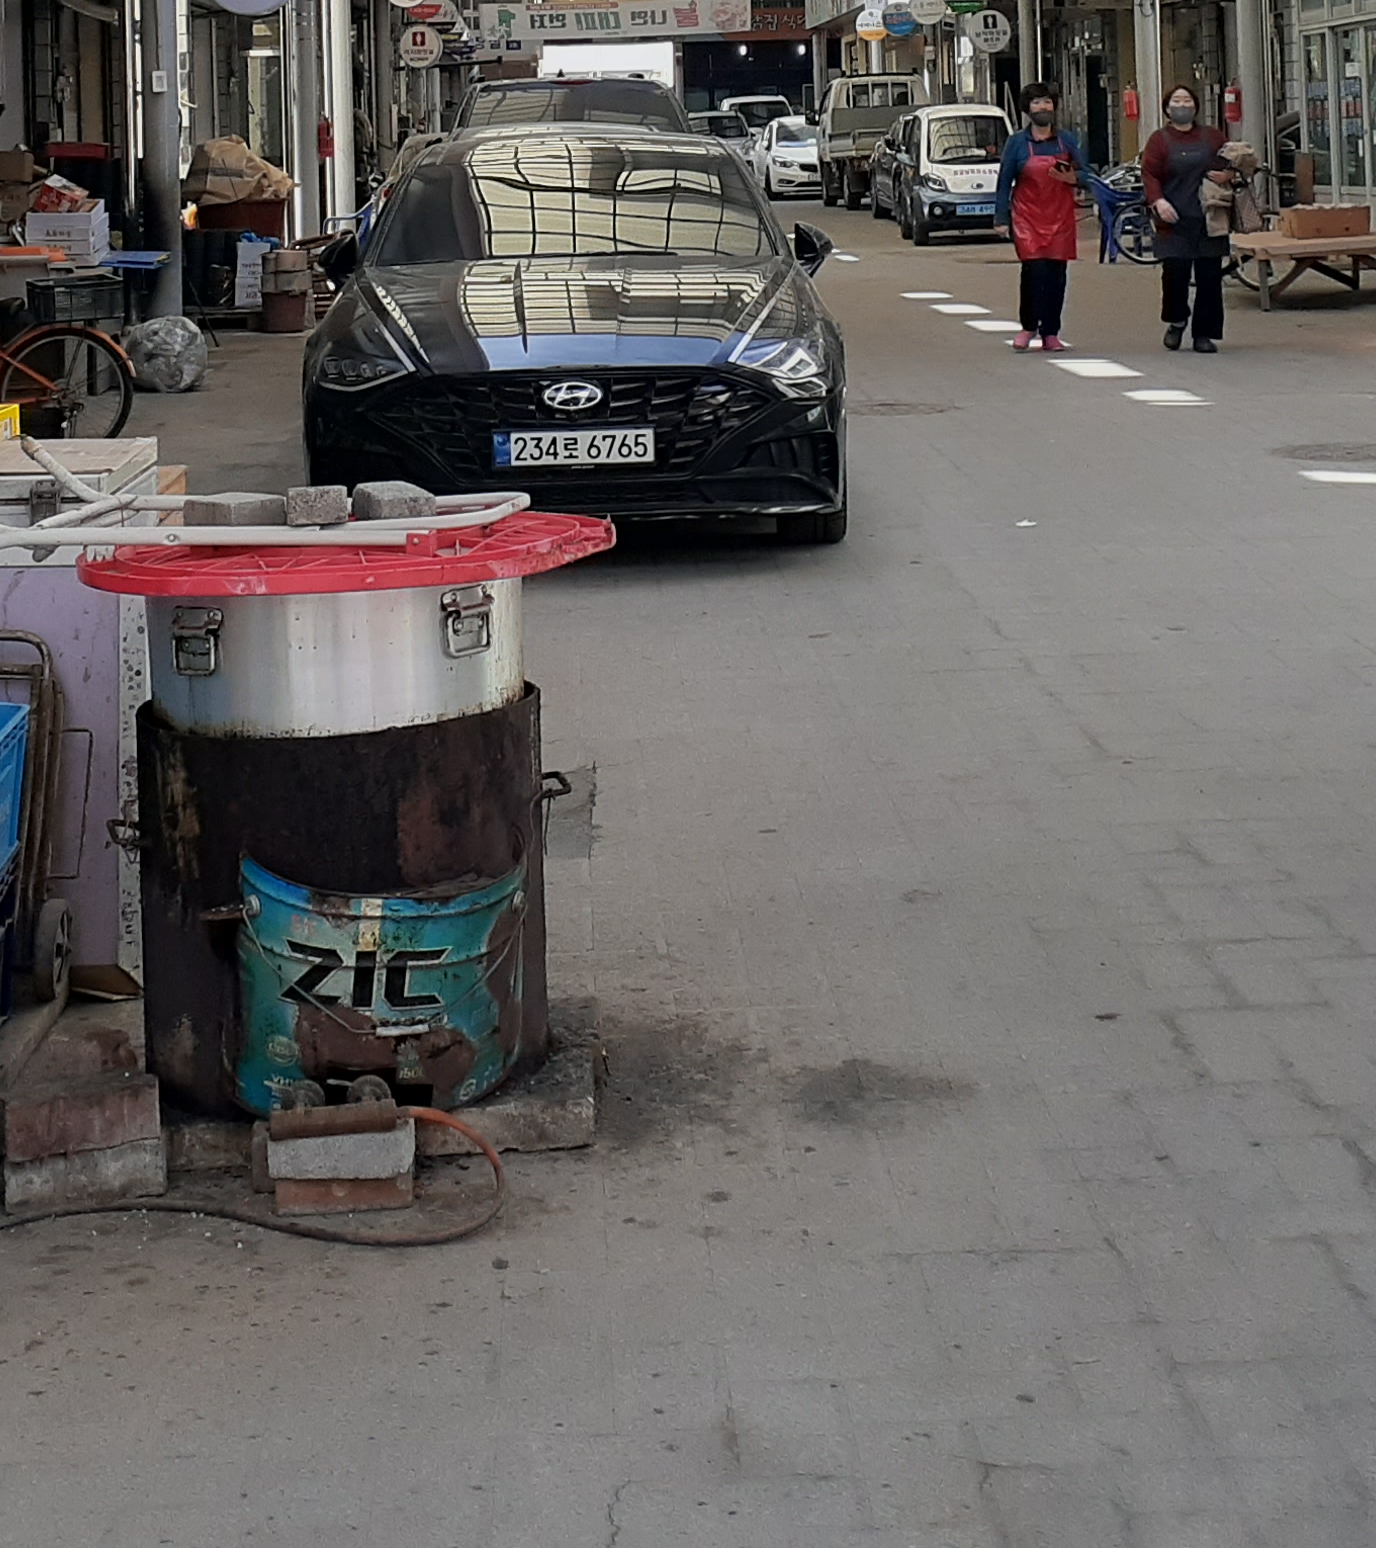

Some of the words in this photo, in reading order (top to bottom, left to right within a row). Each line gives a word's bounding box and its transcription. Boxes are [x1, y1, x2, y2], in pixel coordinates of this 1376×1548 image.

[513, 436, 581, 462] 234로
[586, 433, 650, 461] 6765
[279, 938, 452, 1010] ZIC
